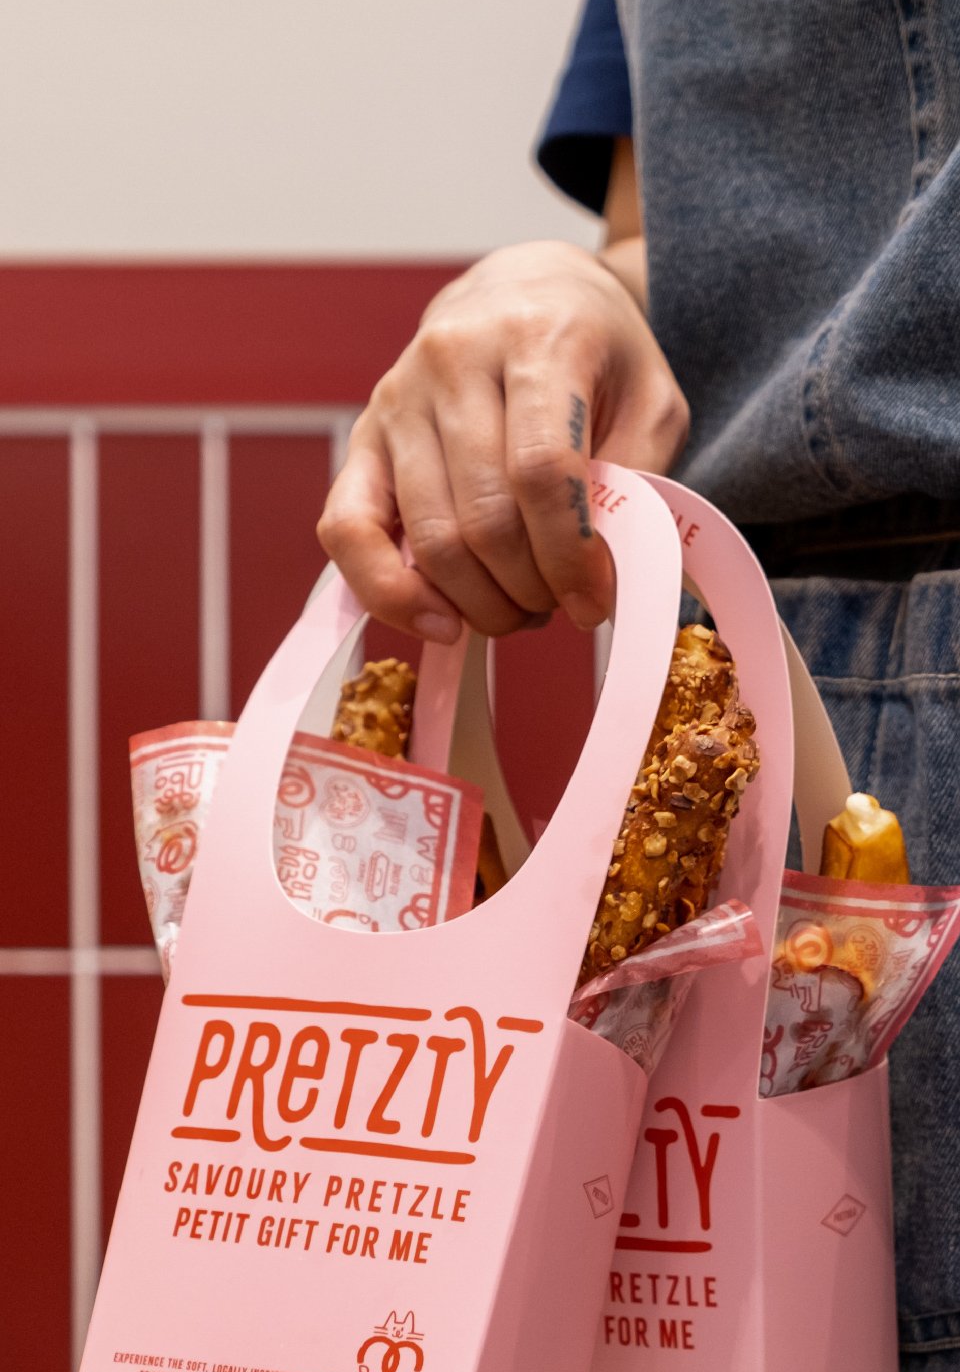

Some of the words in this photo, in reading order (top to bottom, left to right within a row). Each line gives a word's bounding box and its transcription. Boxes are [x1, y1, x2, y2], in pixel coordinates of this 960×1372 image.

[164, 1161, 312, 1203] SAVOURY
[323, 1175, 471, 1222] PRETZLE
[172, 1207, 251, 1244] PETIT
[257, 1216, 319, 1251] GIFT
[326, 1223, 380, 1258] FOR
[388, 1231, 433, 1263] ME
[603, 1315, 650, 1348] FOR
[658, 1318, 695, 1350] ME
[113, 1352, 165, 1367] EXPERIENCE
[168, 1358, 183, 1369] THE
